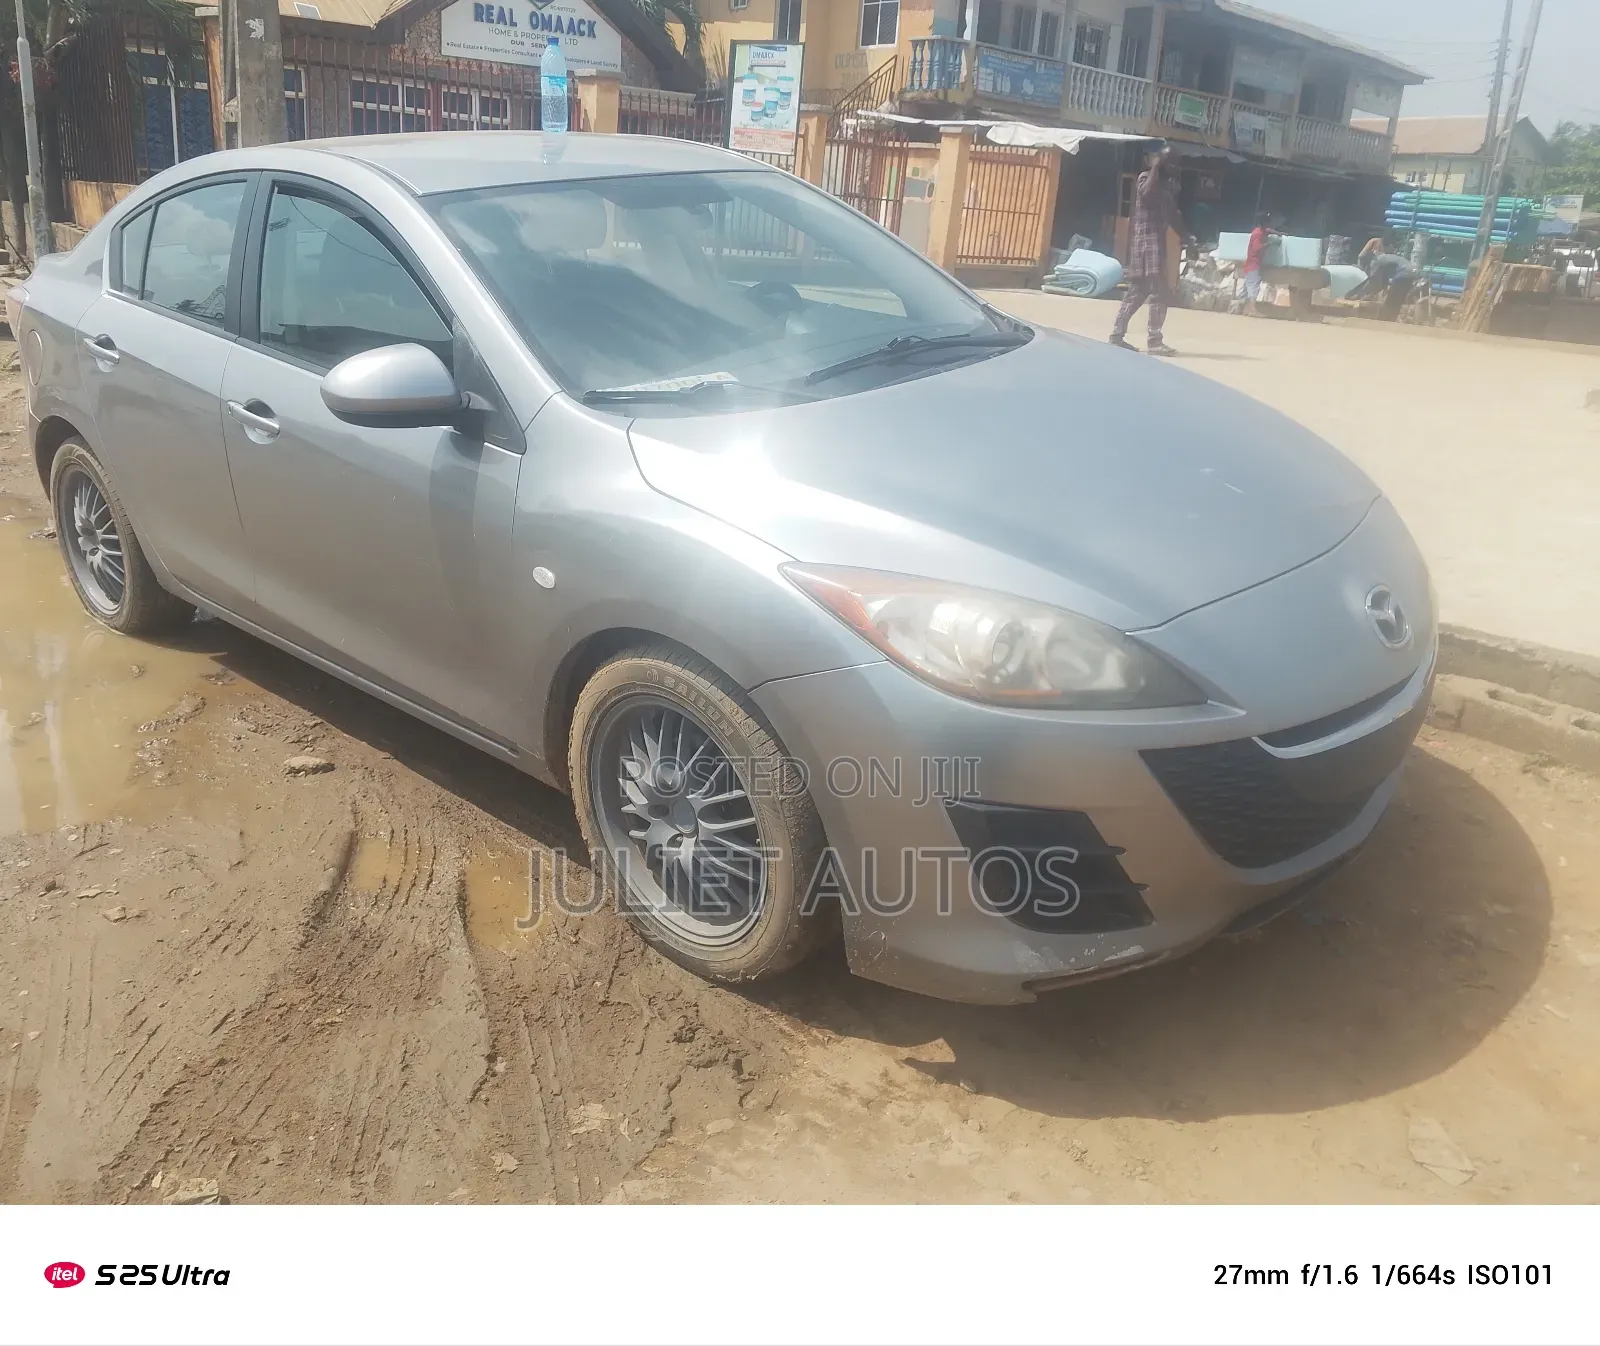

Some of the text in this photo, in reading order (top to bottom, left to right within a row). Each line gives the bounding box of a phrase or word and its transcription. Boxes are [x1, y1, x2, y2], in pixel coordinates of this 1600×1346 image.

[474, 2, 597, 38] REAL OMAACK
[484, 46, 510, 54] Properties
[489, 27, 512, 37] HOME
[565, 38, 579, 46] LTD
[663, 675, 734, 736] SAILUN
